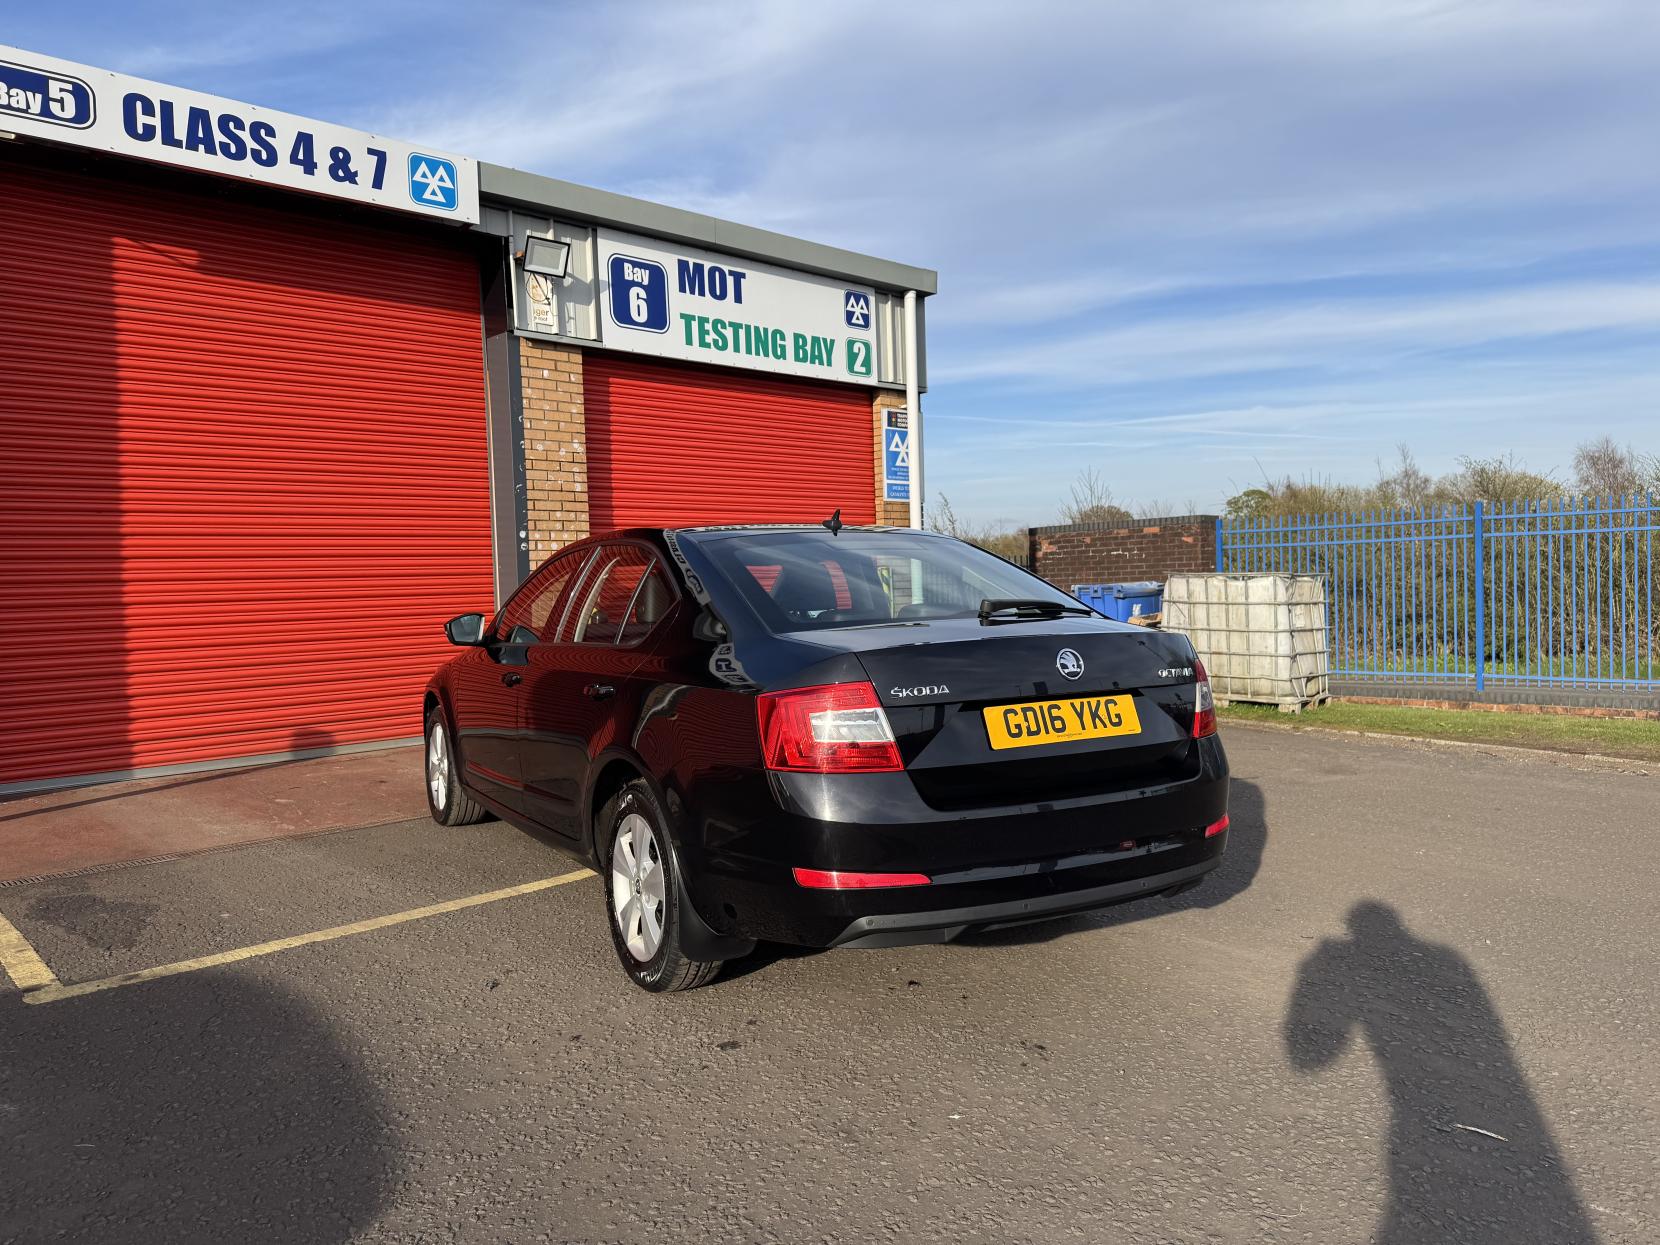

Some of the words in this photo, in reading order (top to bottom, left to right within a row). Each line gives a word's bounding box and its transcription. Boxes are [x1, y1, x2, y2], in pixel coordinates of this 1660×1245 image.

[48, 79, 76, 119] 5
[122, 92, 279, 168] CLASS
[289, 130, 318, 176] 4
[328, 145, 359, 186] &
[366, 147, 388, 191] 7
[623, 262, 650, 287] Bay
[677, 258, 747, 305] MOT
[628, 286, 649, 324] 6
[679, 312, 788, 362] TESTING
[792, 331, 836, 368] BAY
[851, 341, 867, 374] 2
[1002, 703, 1068, 739] GD16
[1070, 698, 1123, 731] YKG
